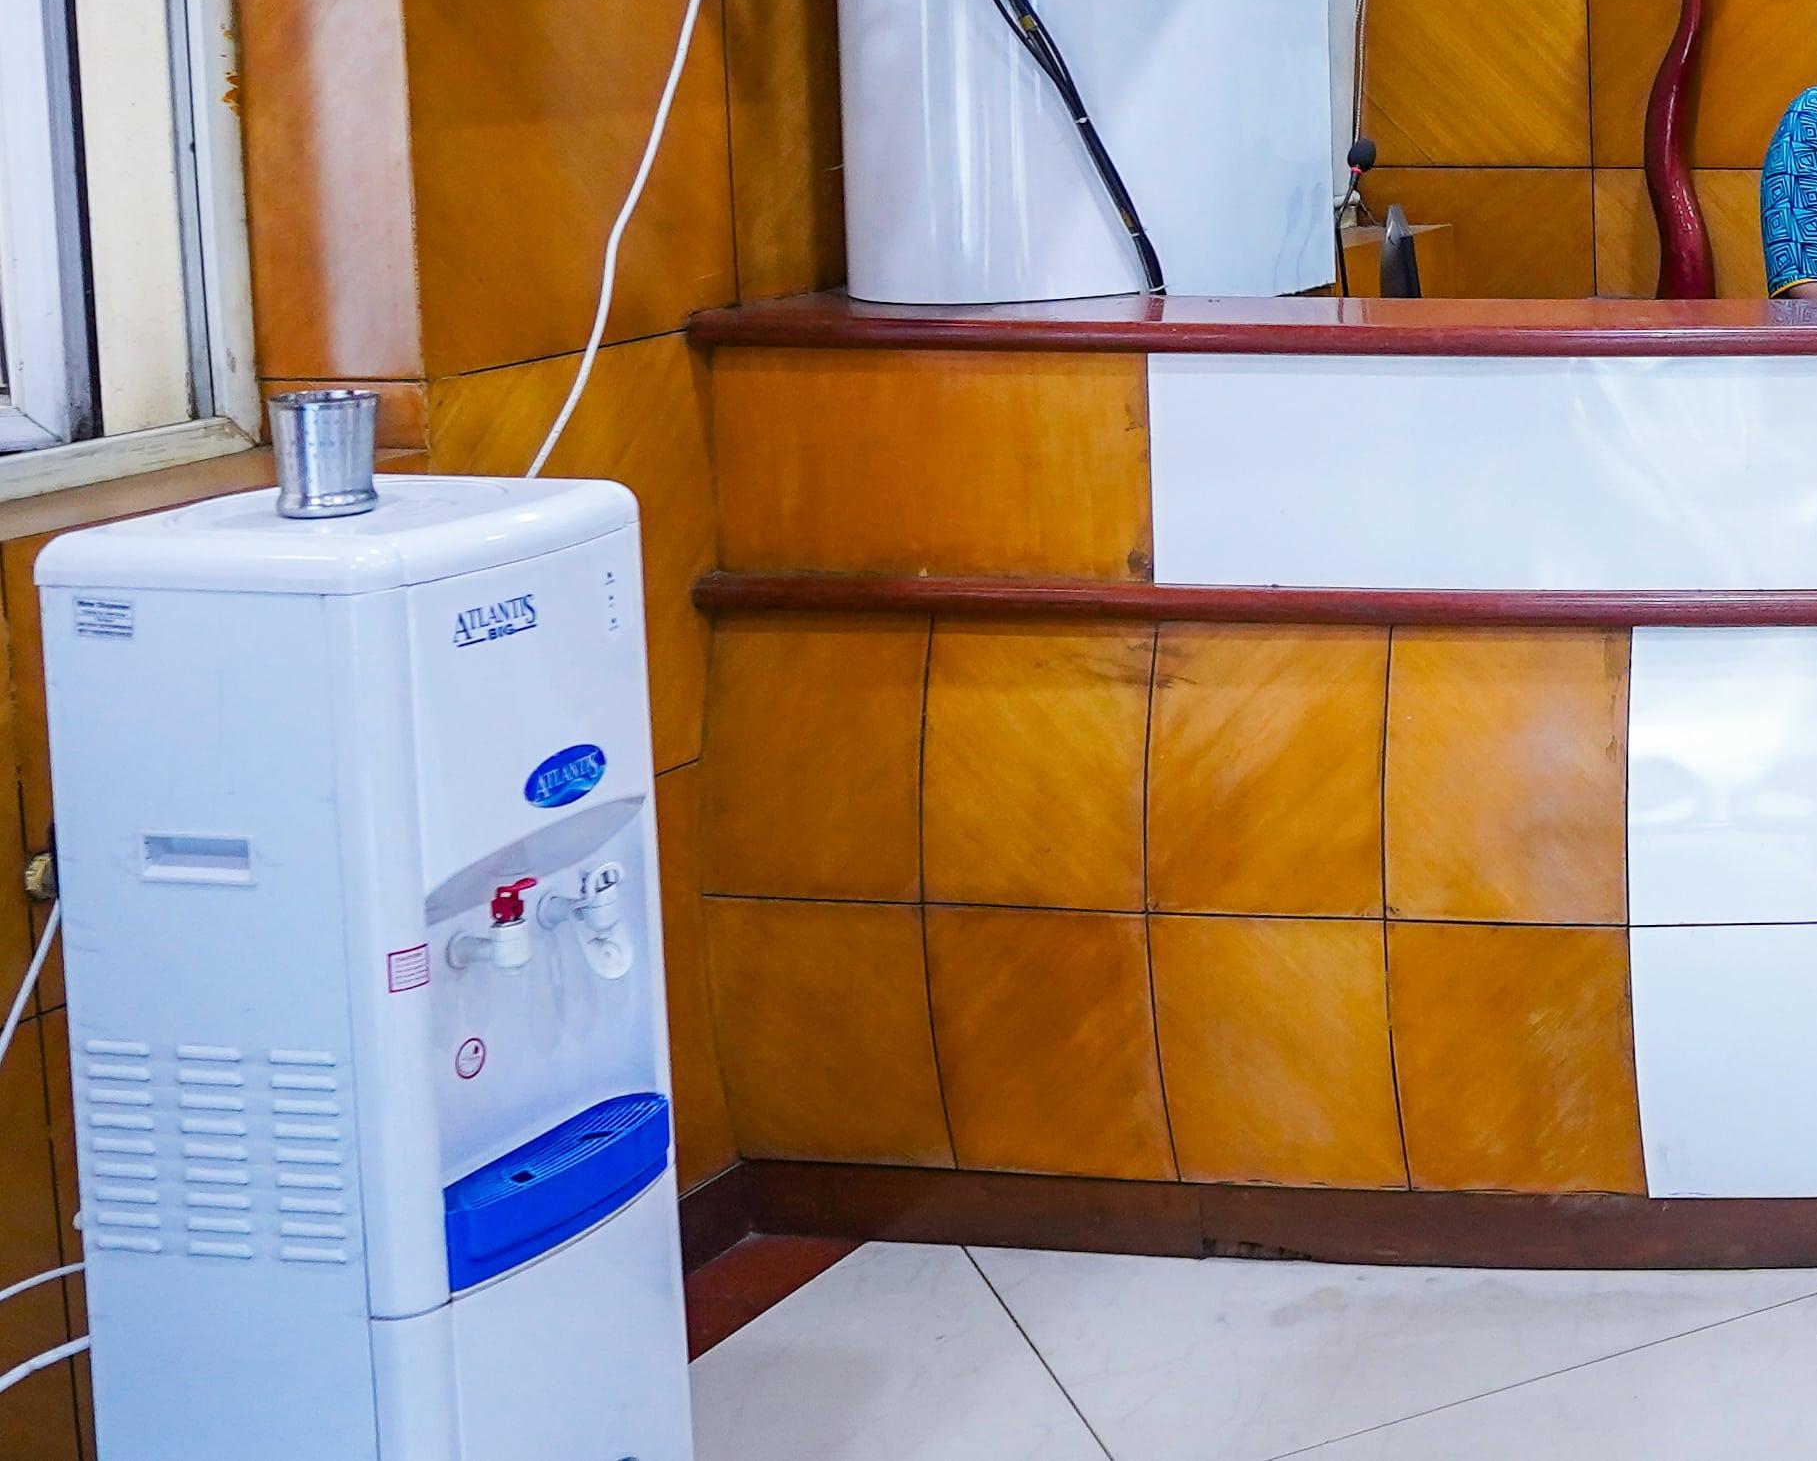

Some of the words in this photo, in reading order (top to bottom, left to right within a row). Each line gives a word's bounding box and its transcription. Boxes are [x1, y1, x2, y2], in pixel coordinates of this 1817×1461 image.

[453, 594, 538, 643] ATLANTIS
[487, 624, 516, 640] BIG
[535, 751, 600, 803] ATLANTIS
